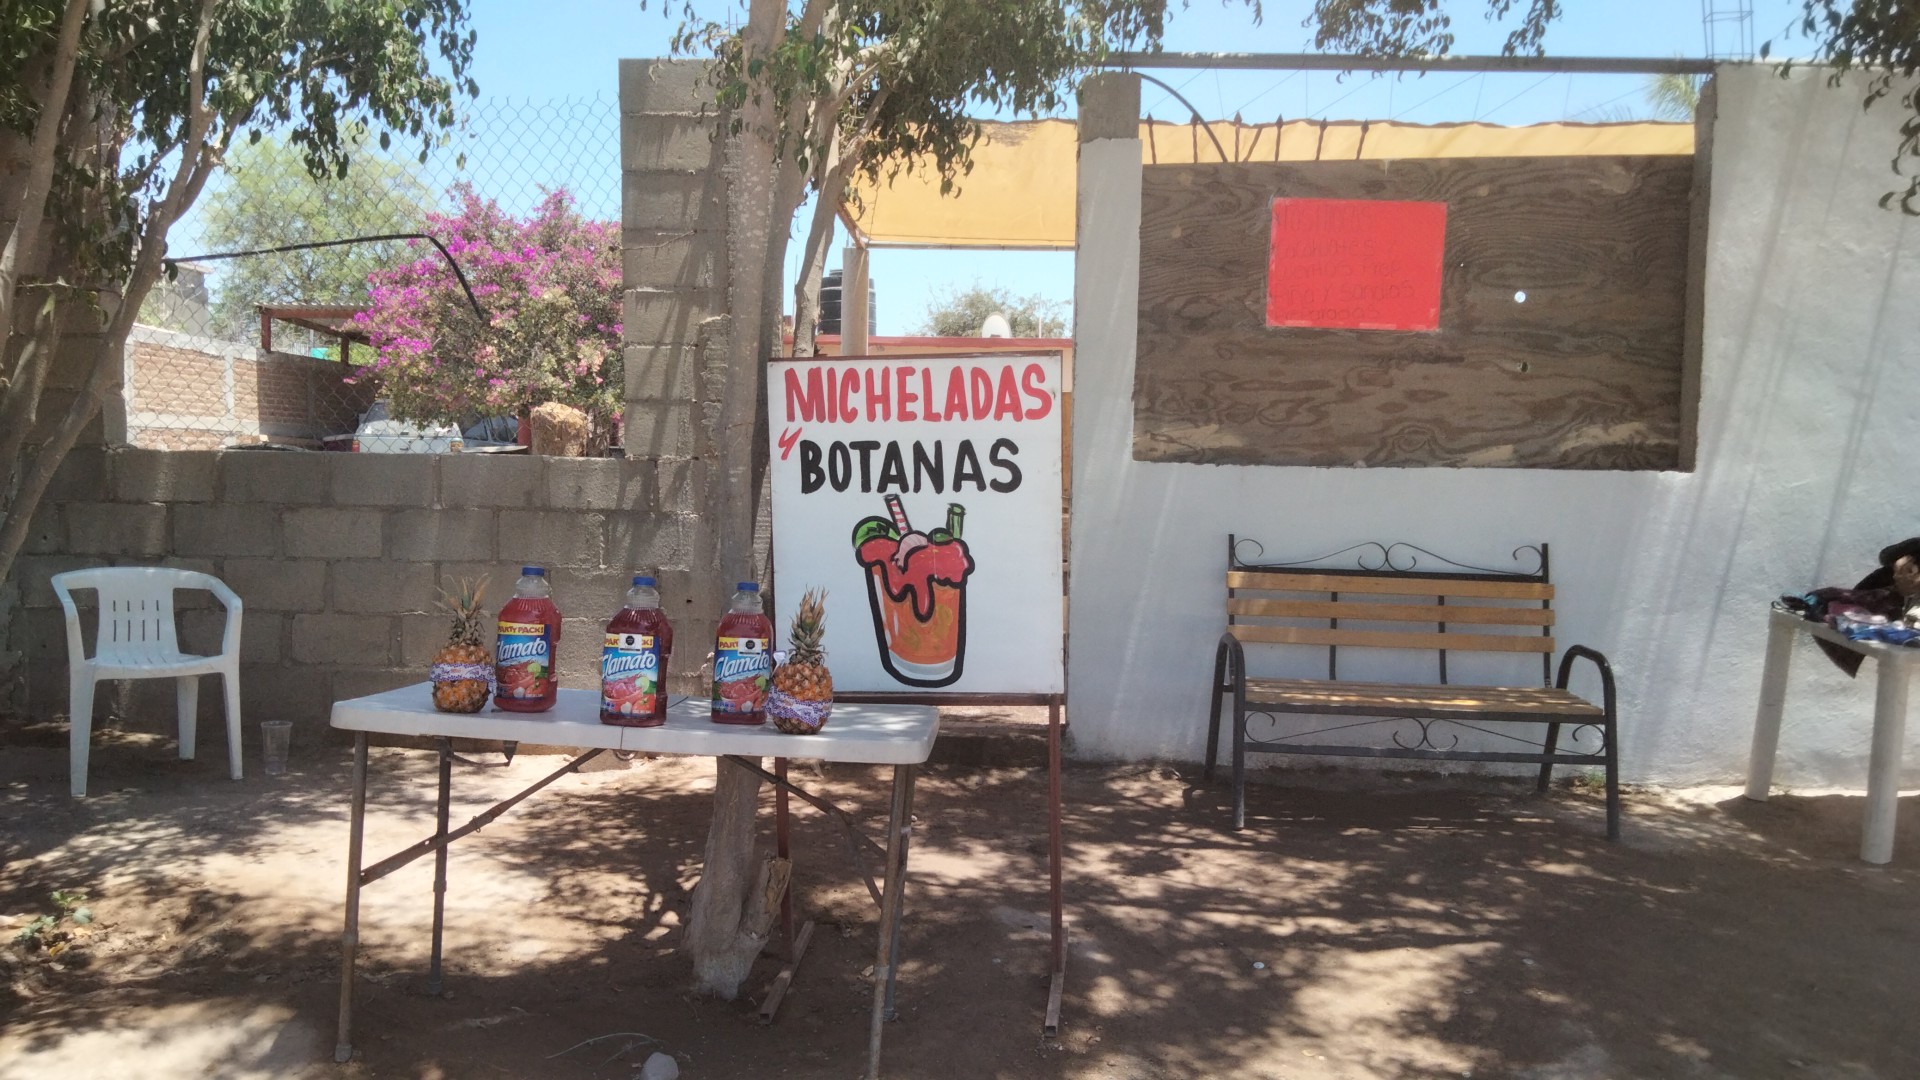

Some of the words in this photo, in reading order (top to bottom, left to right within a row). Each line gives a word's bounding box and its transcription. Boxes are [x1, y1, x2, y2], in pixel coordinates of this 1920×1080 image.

[784, 363, 1052, 424] MICHELADAS
[800, 438, 1022, 494] BOTANAS
[714, 651, 770, 682] Clamato
